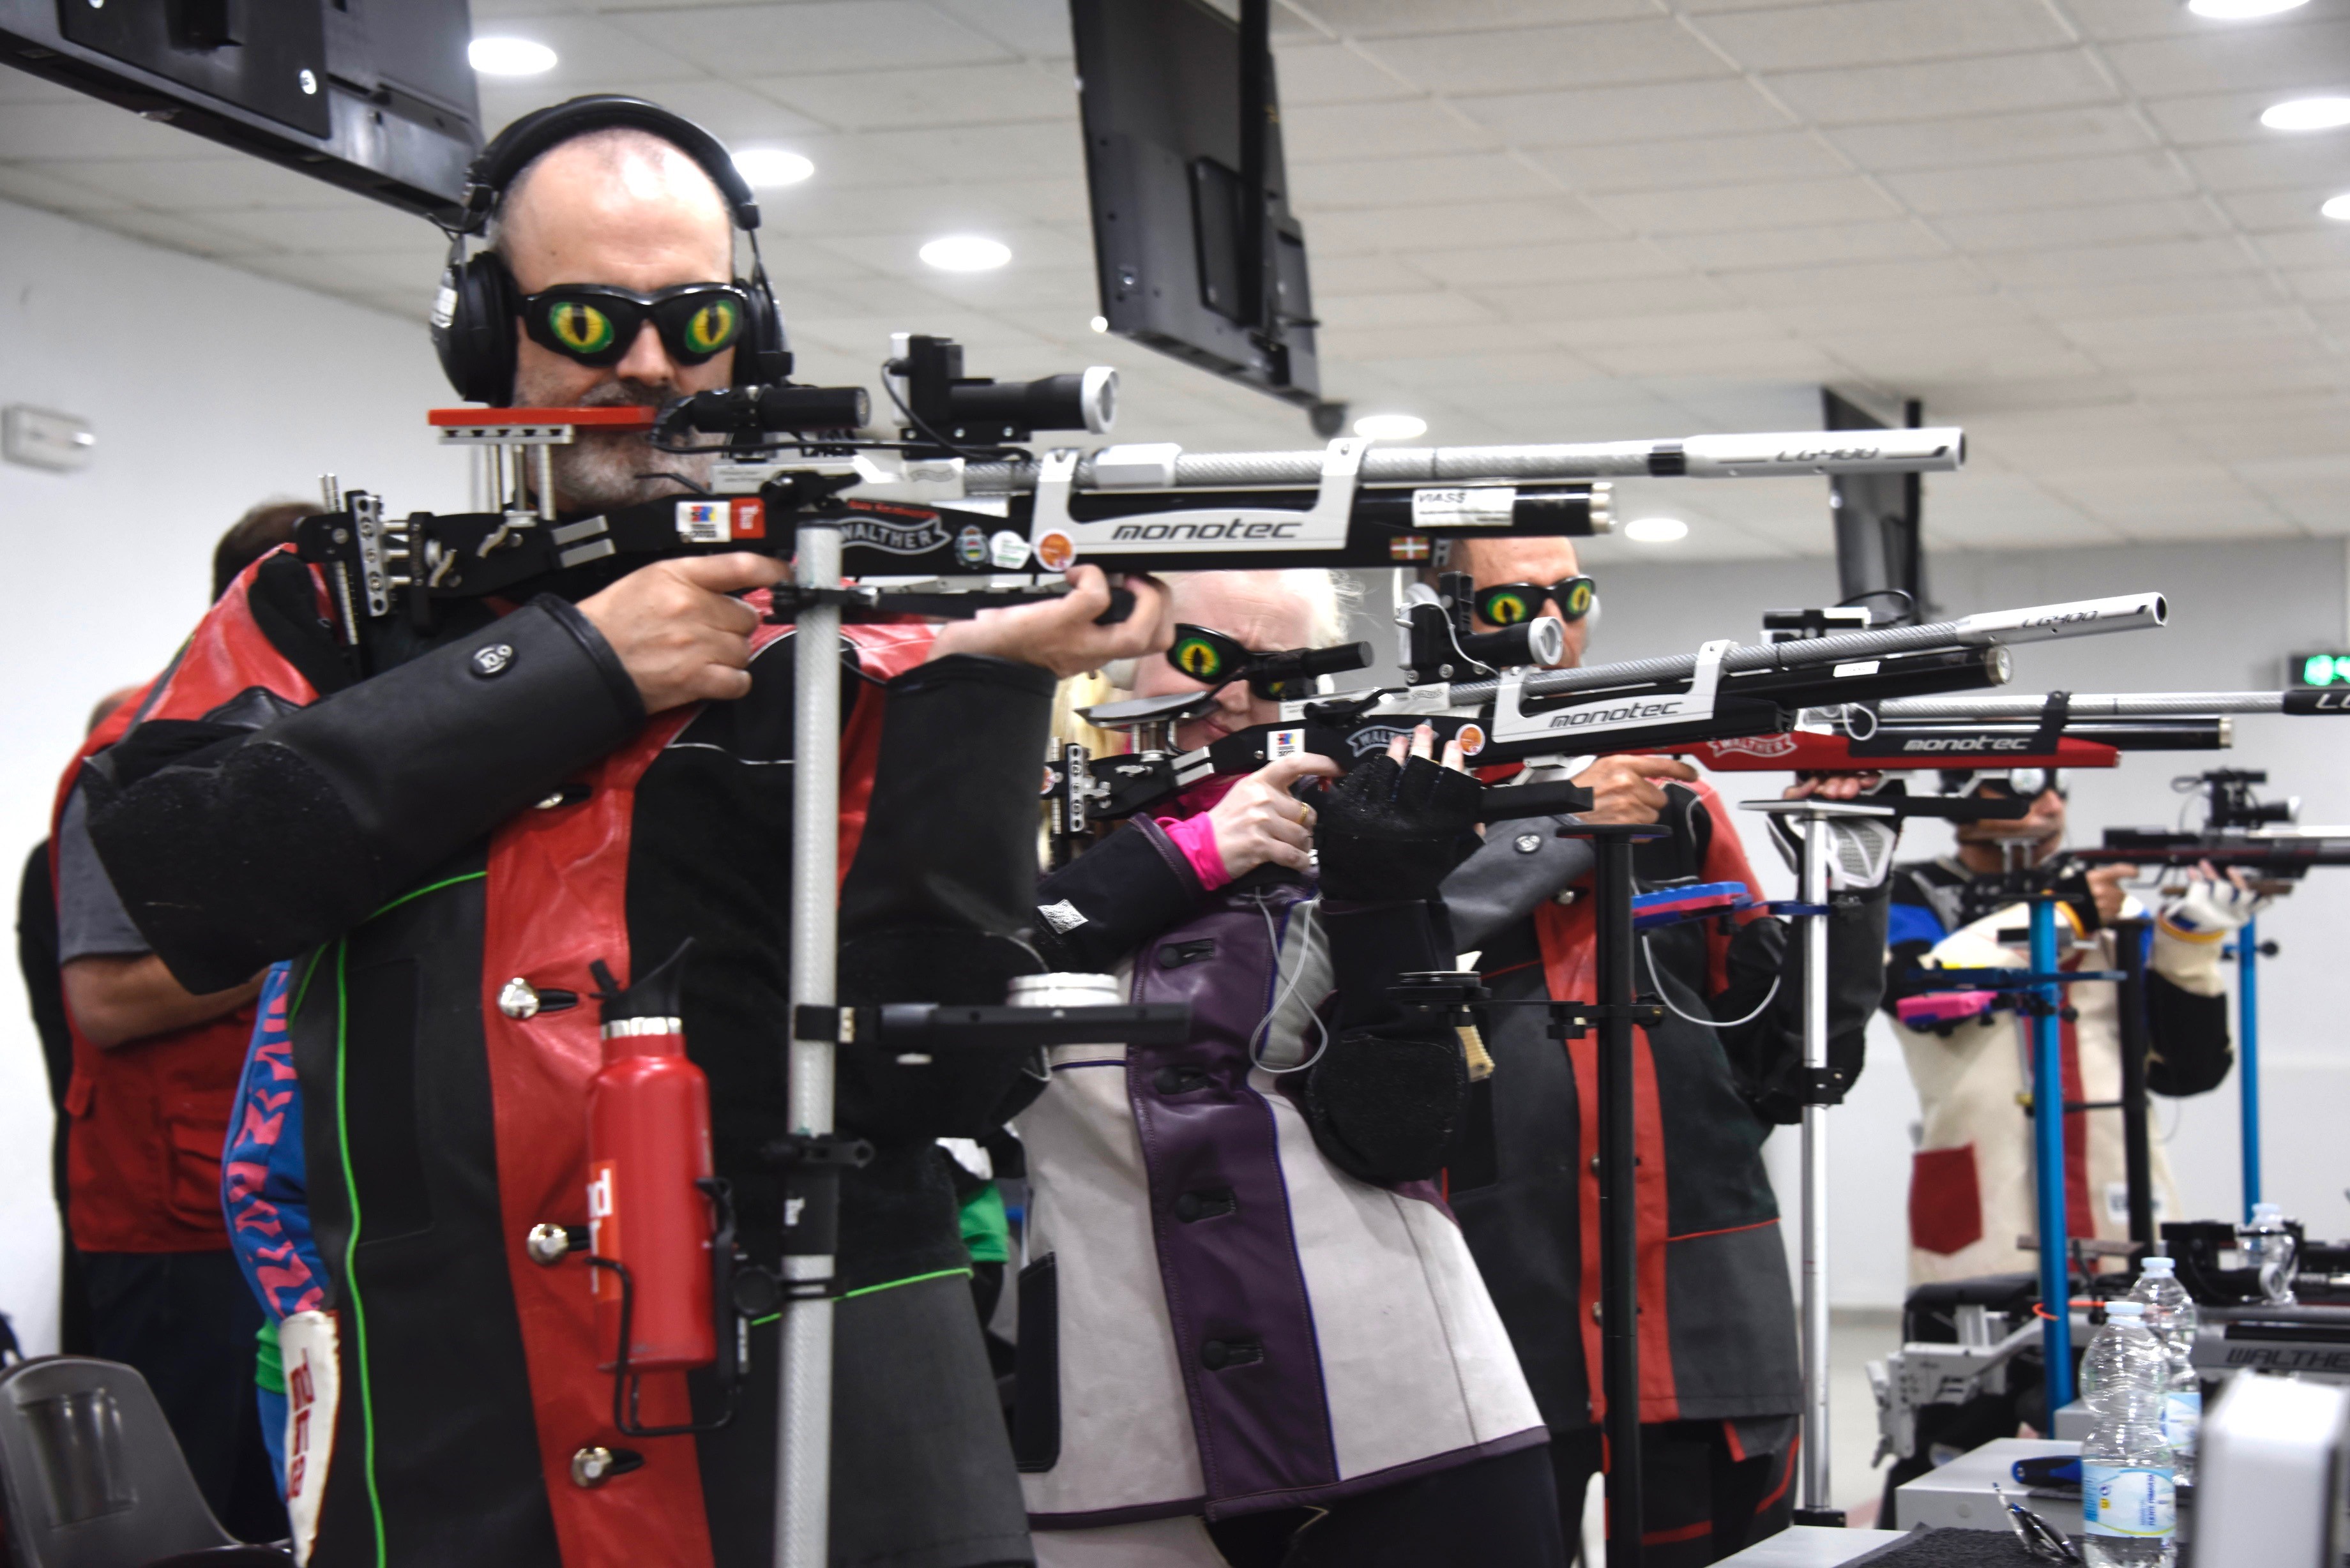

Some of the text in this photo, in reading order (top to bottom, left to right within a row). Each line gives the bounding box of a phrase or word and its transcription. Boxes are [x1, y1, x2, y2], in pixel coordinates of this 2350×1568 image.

[840, 523, 933, 548] WALTHER
[1111, 518, 1303, 540] monotec
[2021, 610, 2098, 628] LG400
[1549, 702, 1685, 728] monotec
[1902, 735, 2033, 751] monotec
